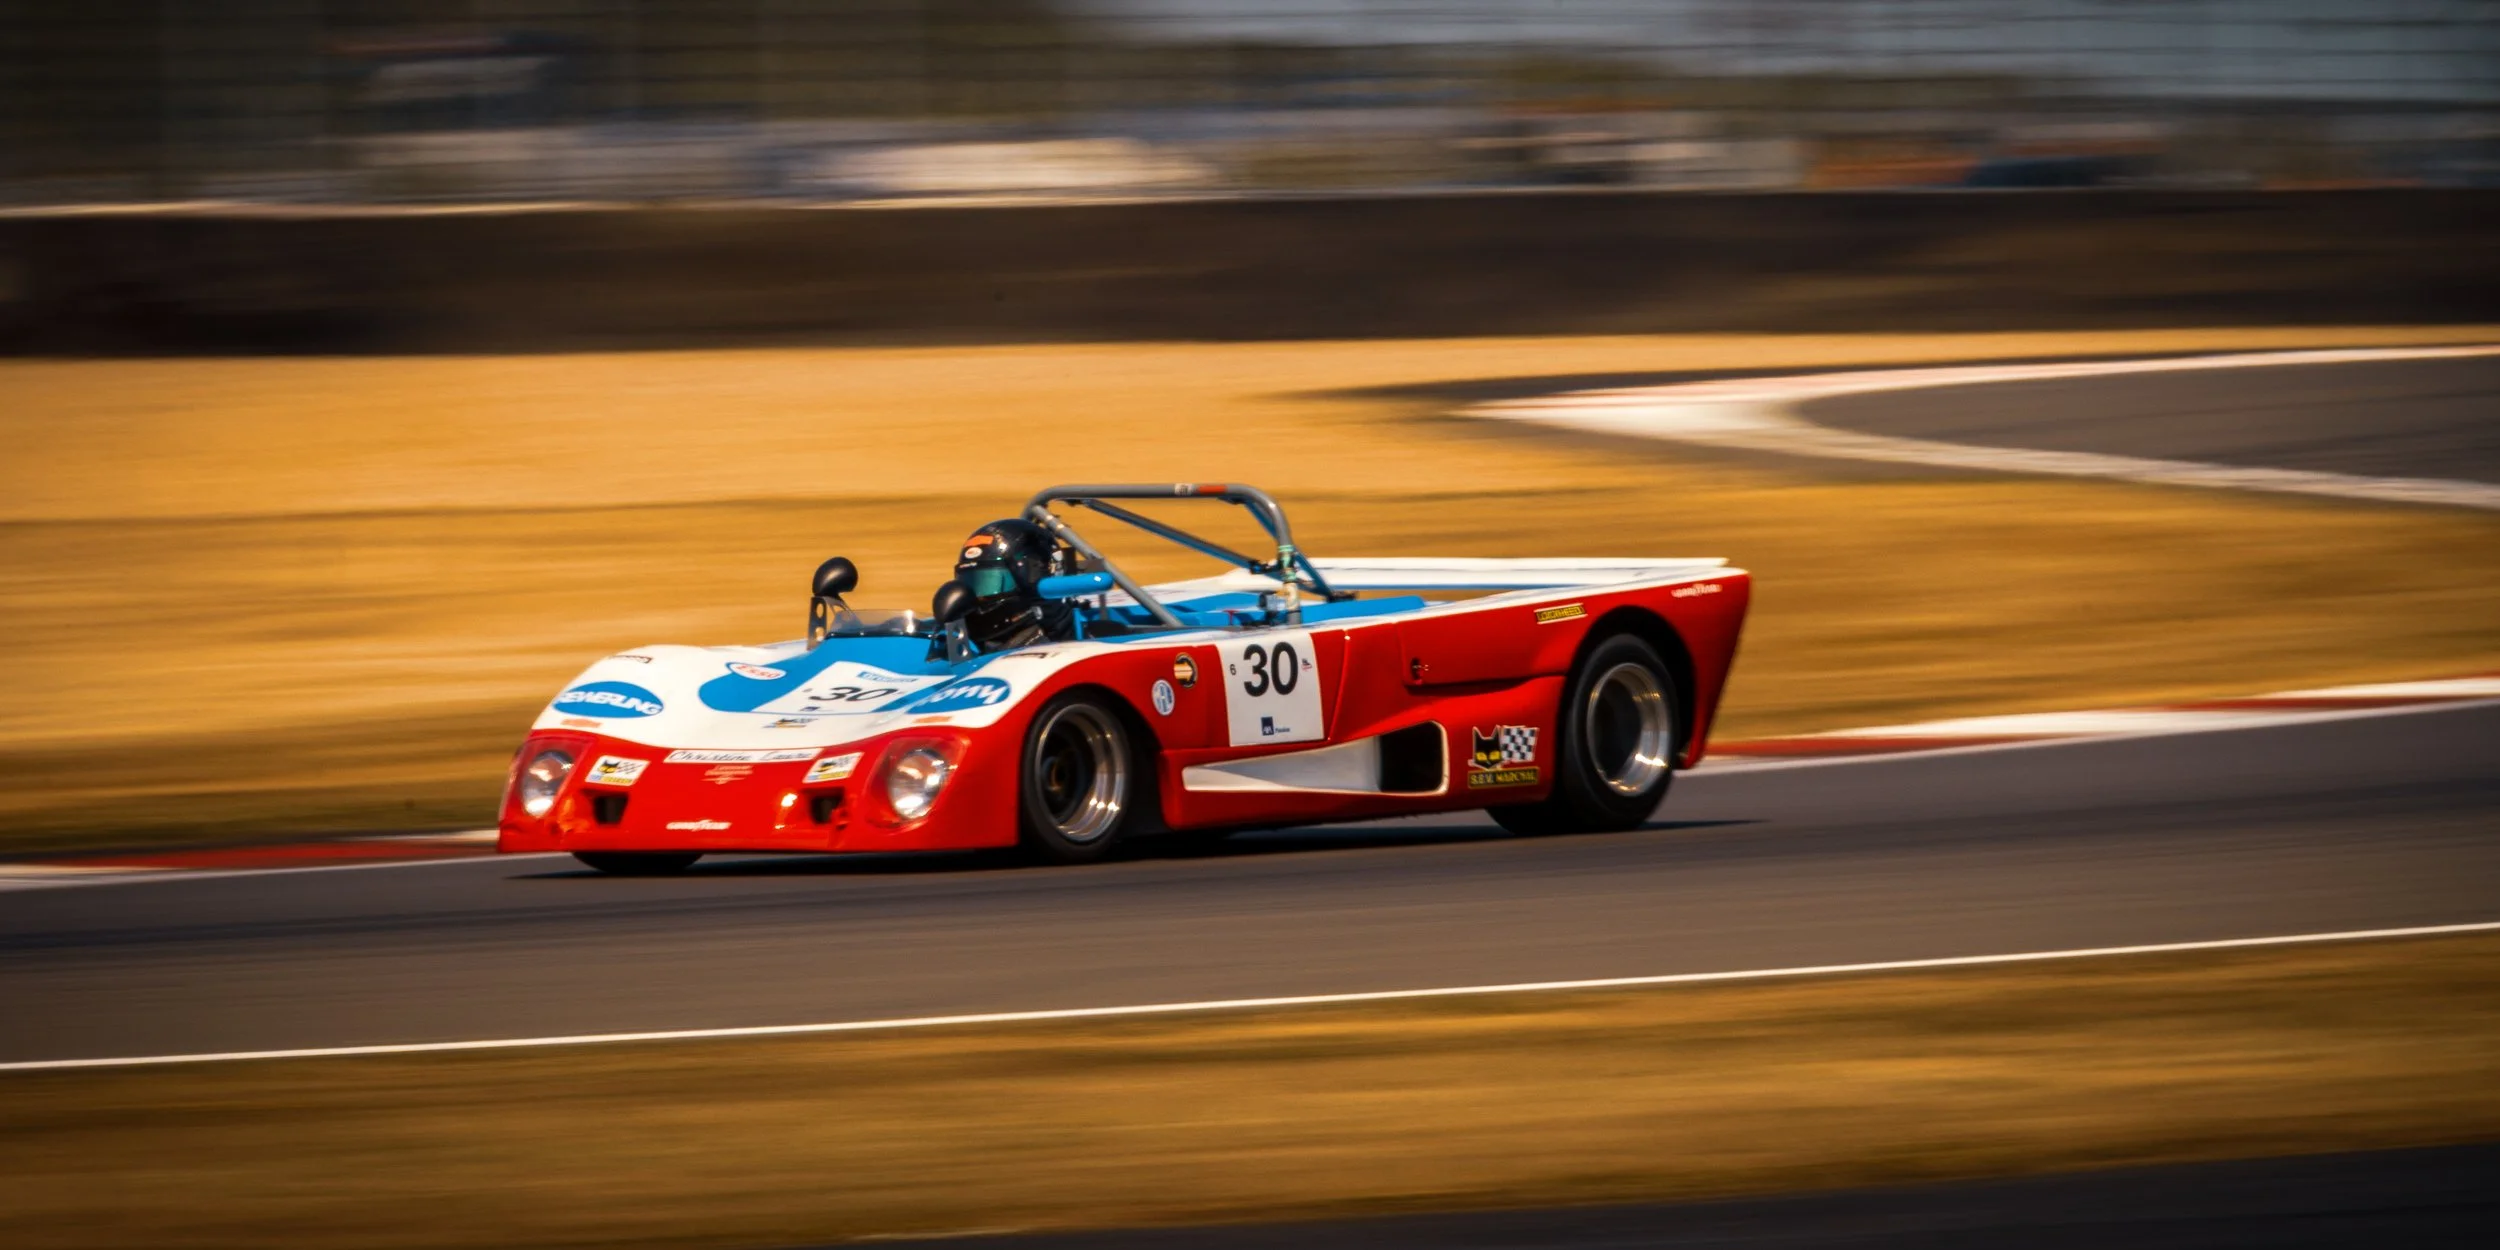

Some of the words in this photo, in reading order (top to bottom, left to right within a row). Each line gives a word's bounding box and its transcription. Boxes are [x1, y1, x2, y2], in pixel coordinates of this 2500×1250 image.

[1229, 663, 1237, 676] 6
[1243, 641, 1298, 697] 30
[808, 686, 899, 702] 30
